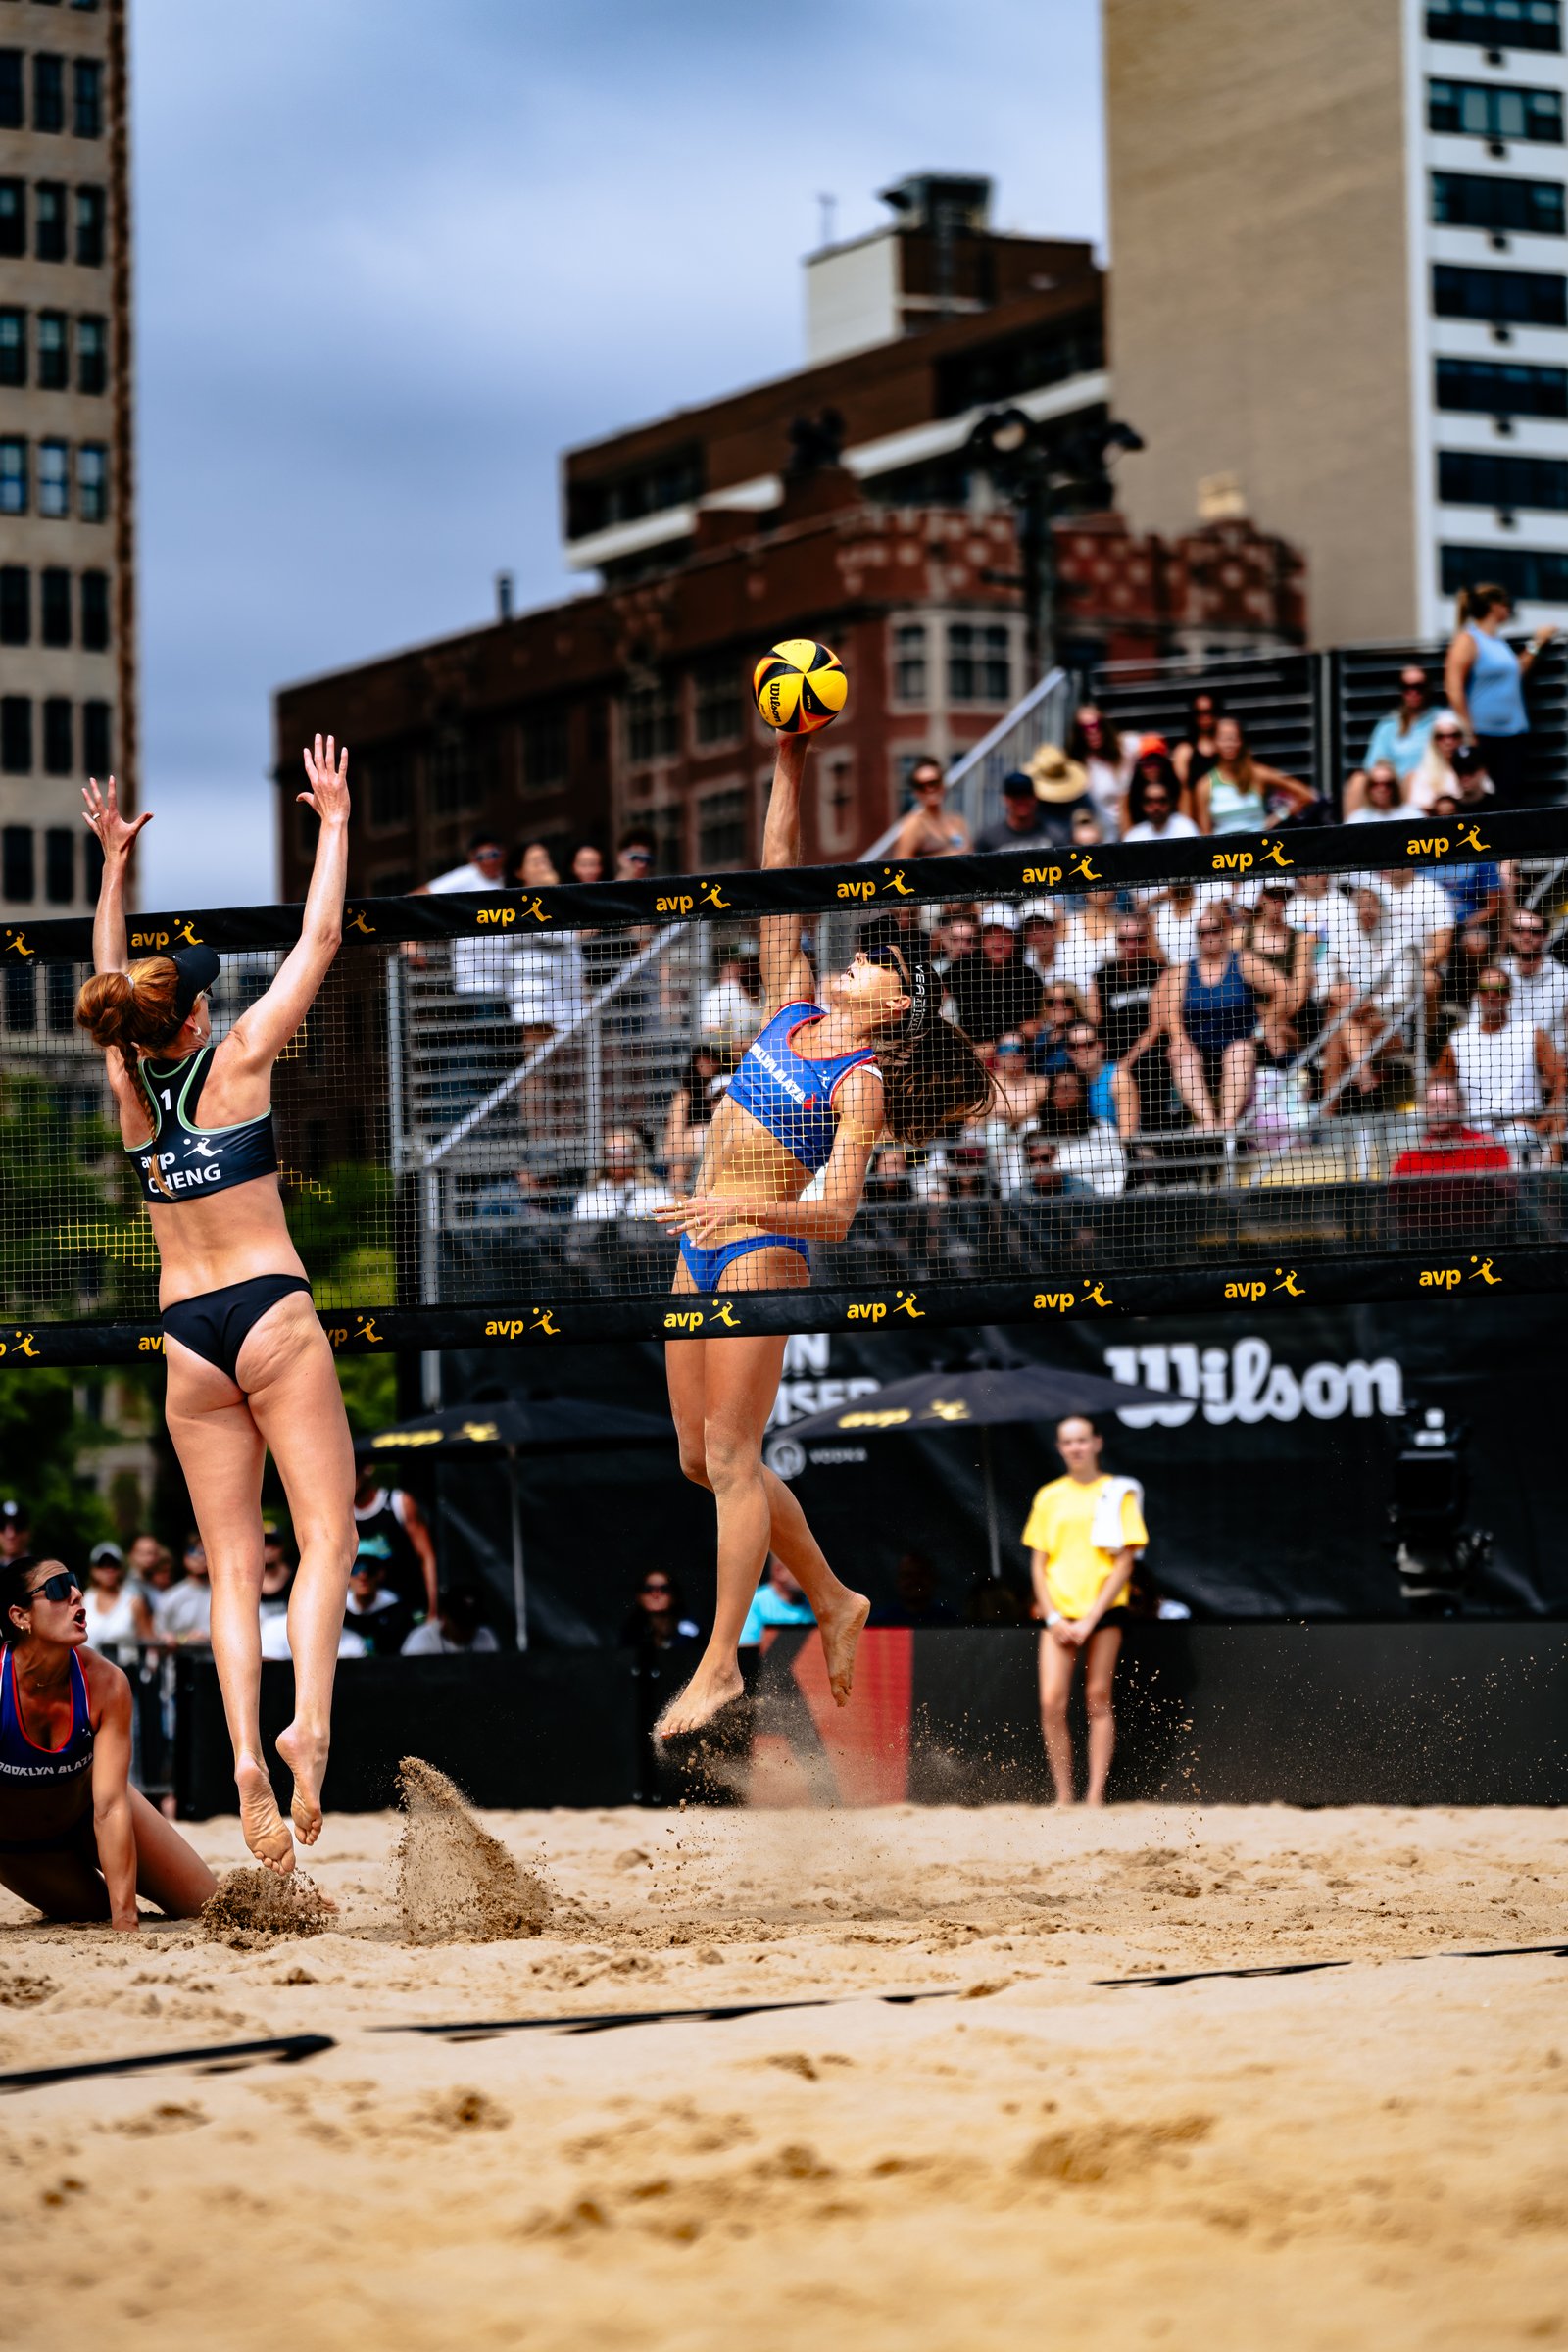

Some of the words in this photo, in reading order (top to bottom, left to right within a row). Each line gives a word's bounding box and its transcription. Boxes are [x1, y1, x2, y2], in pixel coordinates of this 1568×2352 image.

[769, 682, 782, 723] Wilson
[1407, 838, 1450, 858] avp
[1212, 853, 1254, 872] avp
[1022, 866, 1063, 887] avp
[837, 882, 876, 902] avp
[655, 896, 694, 914] avp
[476, 908, 516, 927] avp
[130, 931, 170, 950] avp
[160, 1088, 172, 1111] 1
[148, 1163, 221, 1194] CHENG
[1418, 1270, 1462, 1291] avp
[1224, 1282, 1266, 1302] avp
[846, 1303, 887, 1323] avp
[1033, 1293, 1075, 1313] avp
[485, 1321, 524, 1340] avp
[663, 1312, 704, 1332] avp
[1104, 1337, 1406, 1429] Wilson
